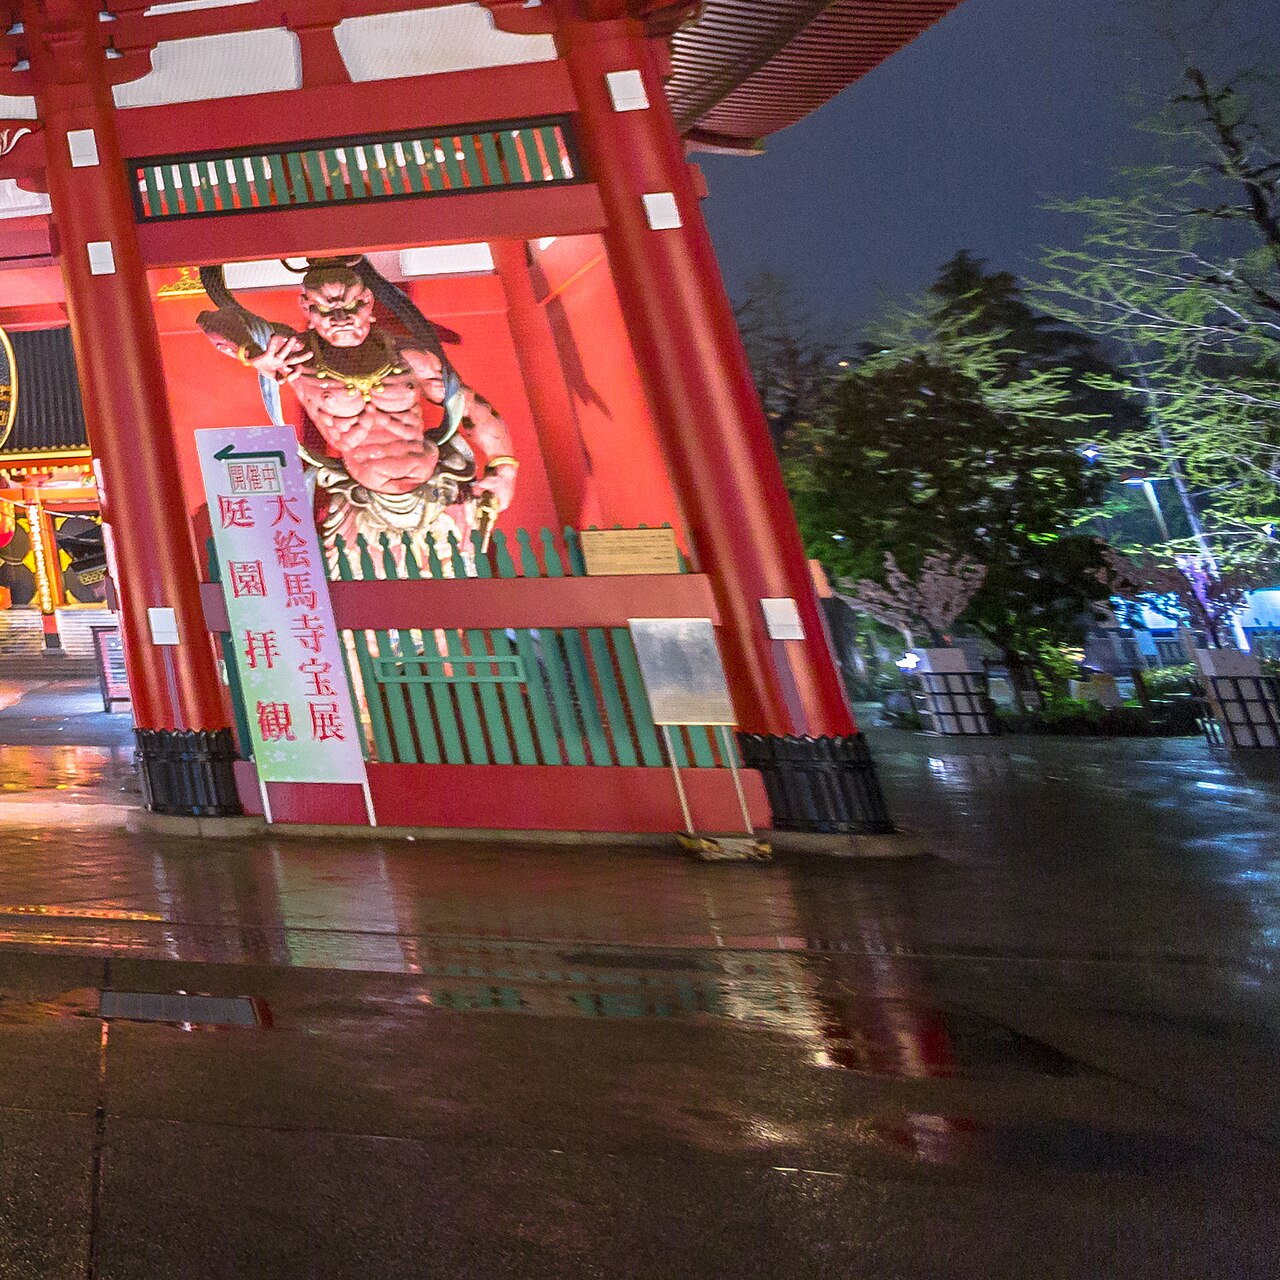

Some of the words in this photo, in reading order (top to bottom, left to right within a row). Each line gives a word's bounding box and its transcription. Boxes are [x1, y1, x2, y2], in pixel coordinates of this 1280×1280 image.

[217, 494, 295, 742] 庭園拝観
[266, 495, 346, 742] 大絵馬寺宝展
